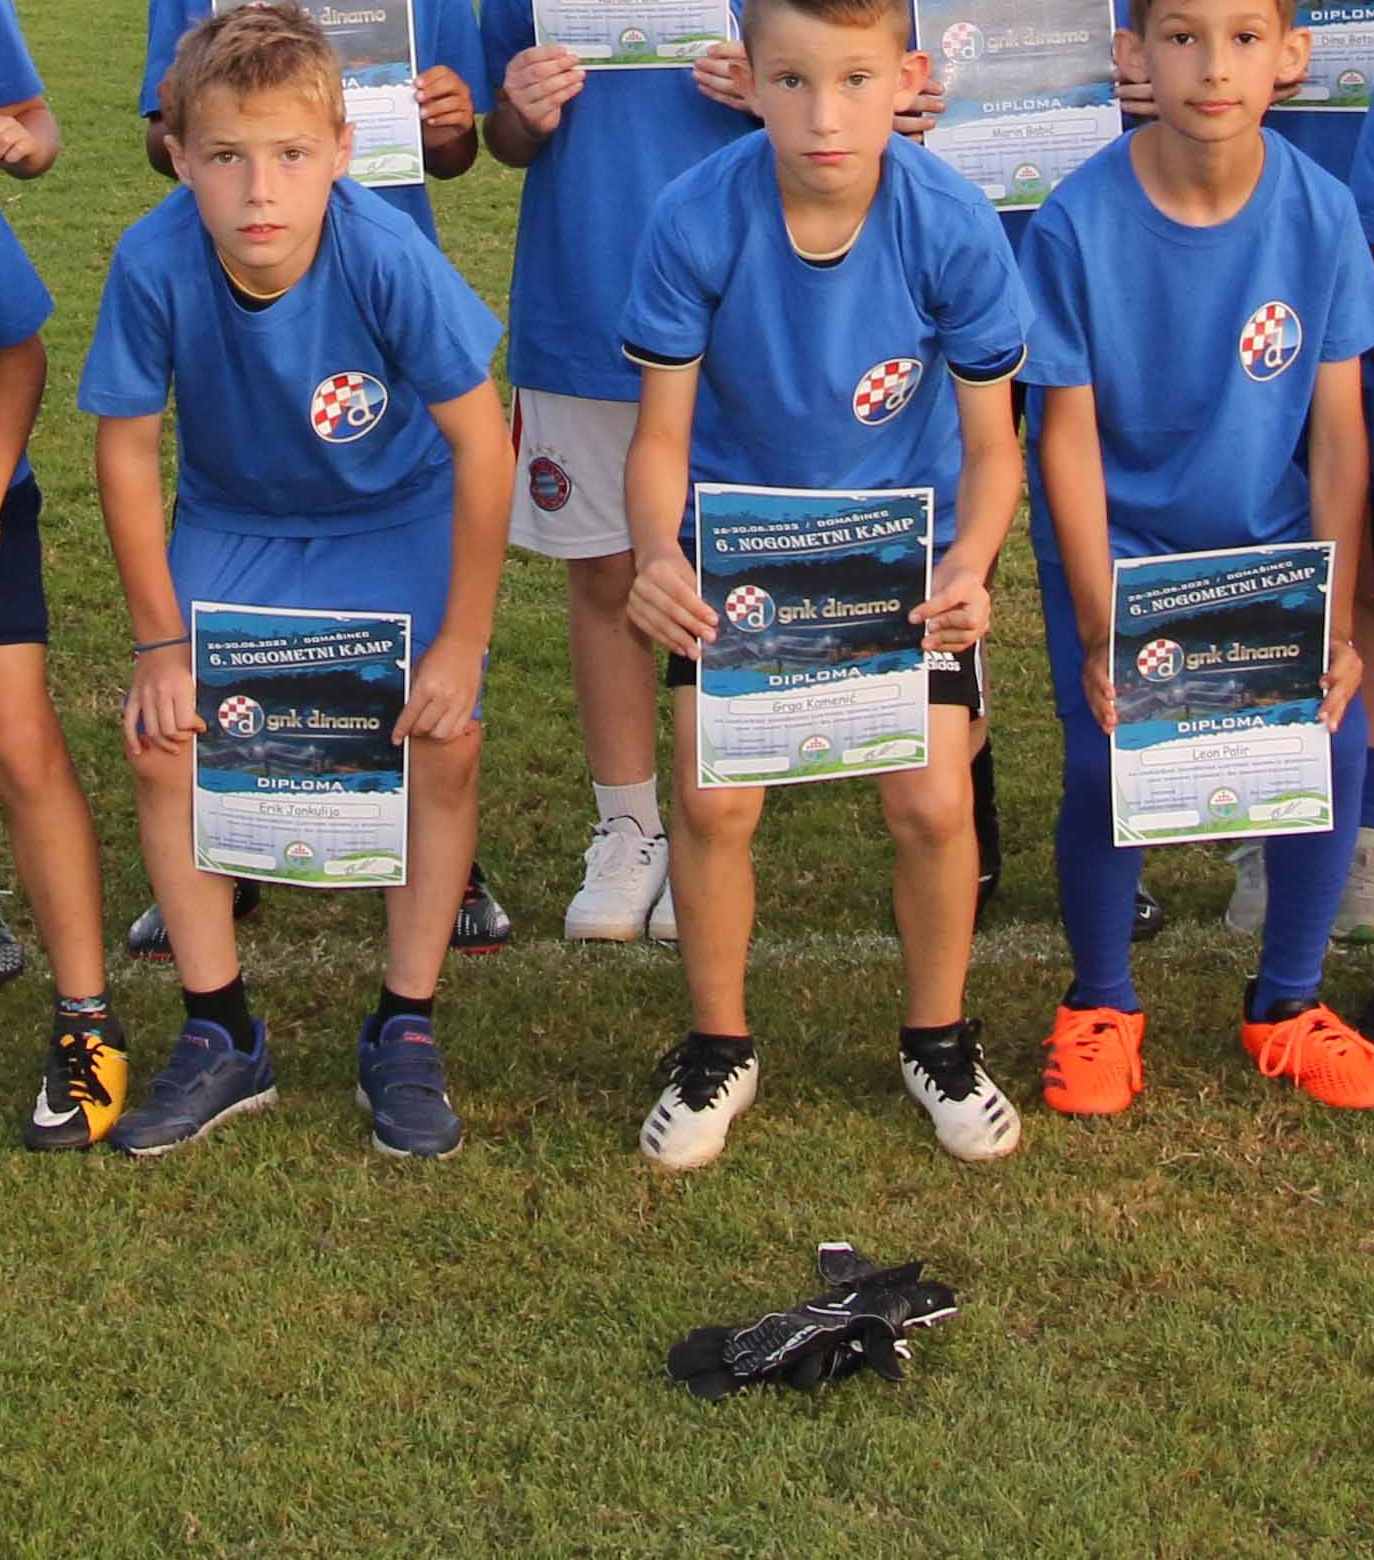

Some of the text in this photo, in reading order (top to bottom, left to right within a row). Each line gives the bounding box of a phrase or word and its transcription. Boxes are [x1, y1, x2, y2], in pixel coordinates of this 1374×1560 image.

[321, 6, 386, 26] dinamo
[987, 27, 1090, 53] gnk dinamo
[983, 99, 1062, 112] DIPLOMA
[716, 518, 914, 552] 6. NOGOMETNI KAMP
[1130, 568, 1316, 616] 6. NOGOMETNI KAMP
[778, 598, 900, 623] gnk dinamo
[210, 640, 393, 666] 6. NOGOMETNI KAMP
[1186, 642, 1299, 669] gnk dinamo
[769, 667, 862, 686] DIPLOMA
[267, 709, 380, 730] gnk dinamo
[1178, 715, 1265, 733] DIPLOMA
[258, 777, 344, 791] DIPLOMA
